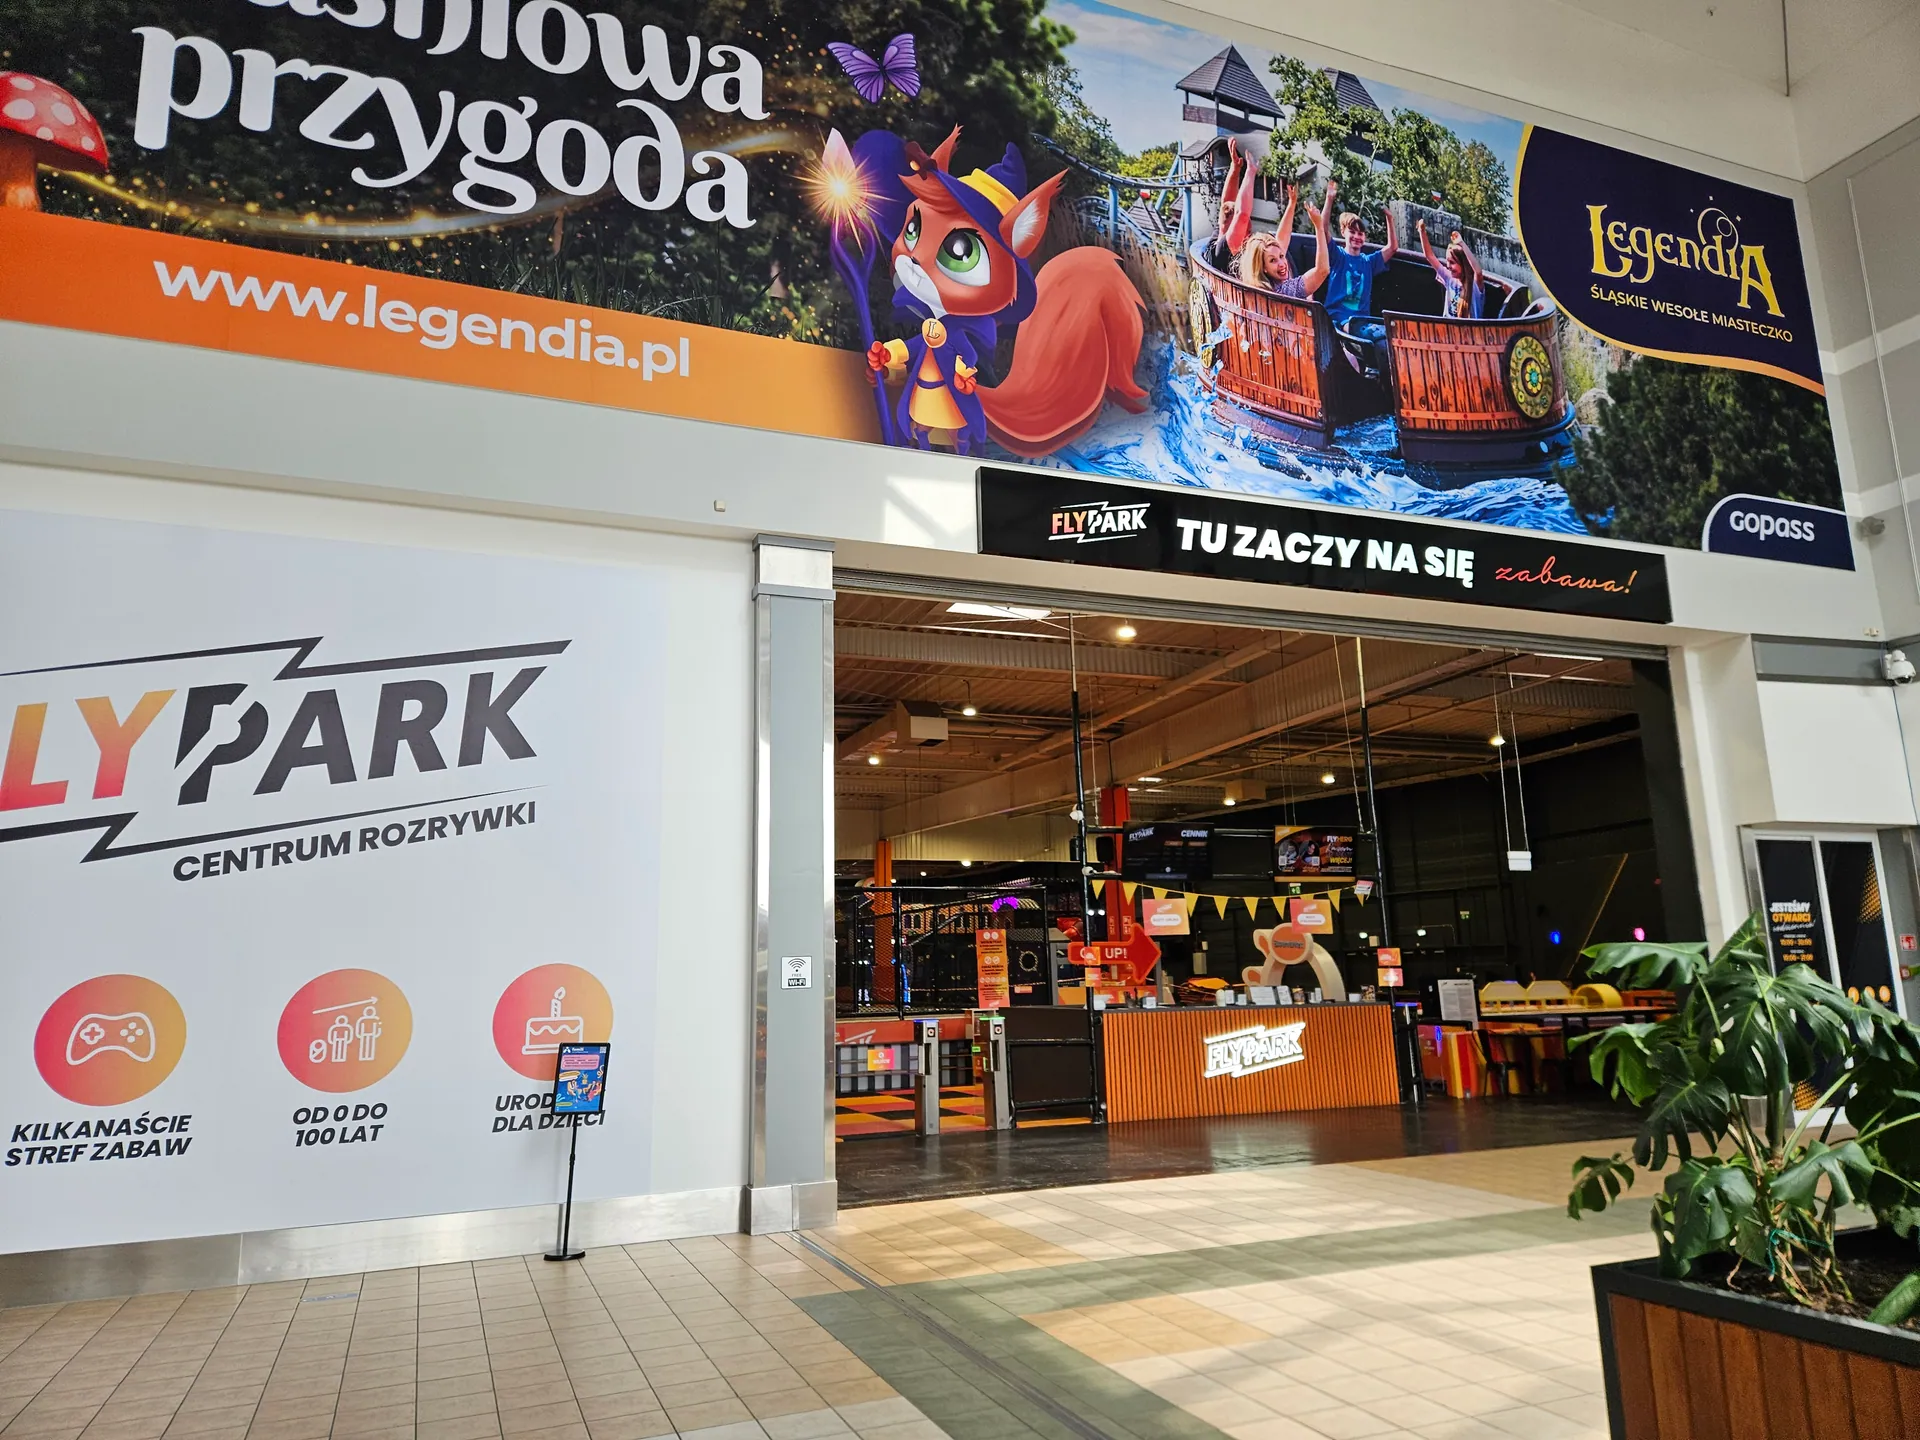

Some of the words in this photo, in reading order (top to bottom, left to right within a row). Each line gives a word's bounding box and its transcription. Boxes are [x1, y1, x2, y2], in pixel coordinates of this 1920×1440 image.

[131, 27, 756, 229] przygoda
[153, 260, 690, 381] www.legendia.pl
[1590, 283, 1649, 310] ŚLĄSKIE
[1651, 299, 1709, 324] WESOŁE
[1712, 313, 1793, 343] MIASTECZKO
[1051, 505, 1147, 540] FLYPARK
[1176, 518, 1227, 553] TU
[1235, 524, 1361, 569] ZACZY
[1366, 539, 1419, 574] NA
[1423, 546, 1475, 588] SIĘ
[1494, 554, 1638, 594] zabawa!
[0, 665, 548, 812] LYPARK
[172, 830, 351, 882] CENTRUM
[359, 801, 536, 852] ROZRYWKI
[1129, 828, 1154, 841] FLYPARK
[1180, 829, 1208, 838] CENNIK
[1105, 948, 1127, 959] UP!
[1208, 1030, 1303, 1071] FLYPARK
[11, 1112, 193, 1142] KILKANAŚCIE
[292, 1108, 330, 1126] OD
[333, 1108, 348, 1122] 0
[351, 1104, 388, 1121] DO
[492, 1114, 533, 1133] DLA
[4, 1145, 87, 1166] STREF
[90, 1137, 193, 1161] ZABAW
[295, 1129, 336, 1147] 100
[339, 1125, 384, 1144] LAT
